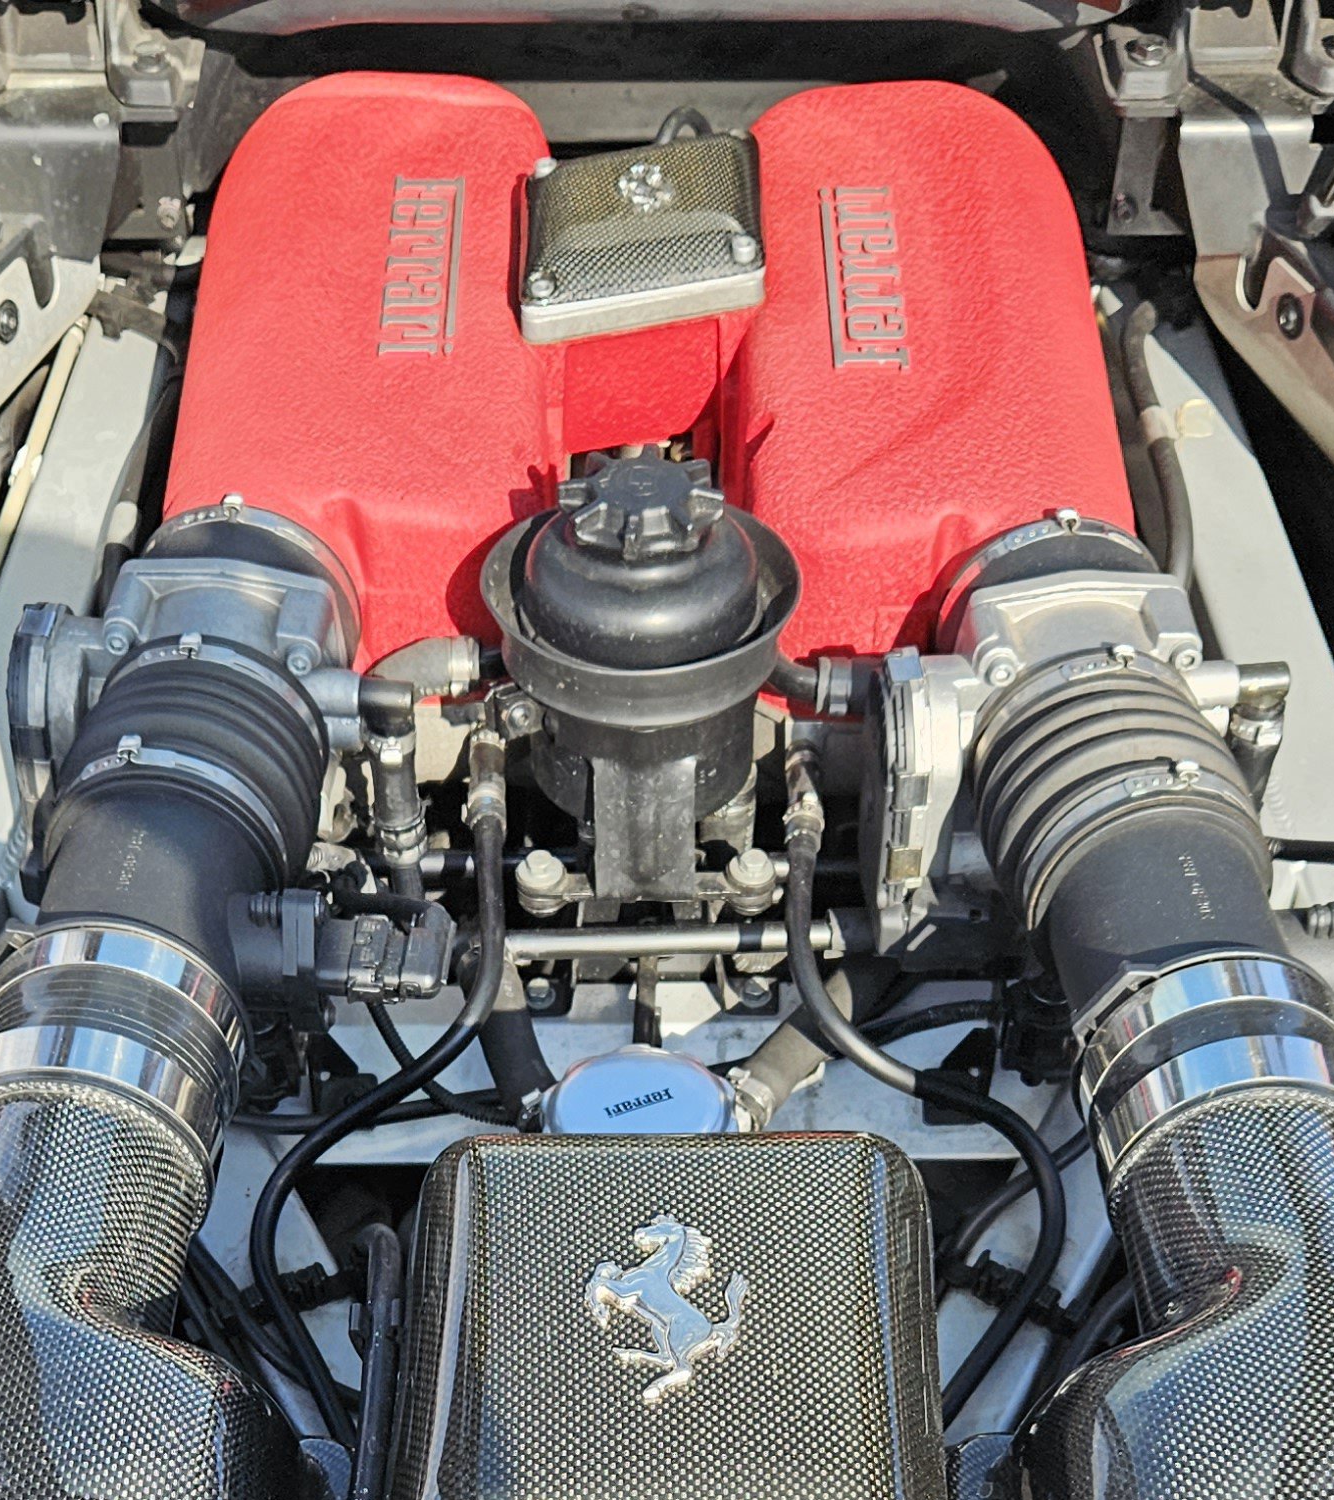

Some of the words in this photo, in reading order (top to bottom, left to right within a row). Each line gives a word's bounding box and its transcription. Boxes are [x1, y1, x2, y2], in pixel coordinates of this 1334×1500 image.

[378, 175, 464, 357] Ferrari
[818, 185, 909, 370] Ferrari
[603, 1087, 674, 1119] Ferrari
